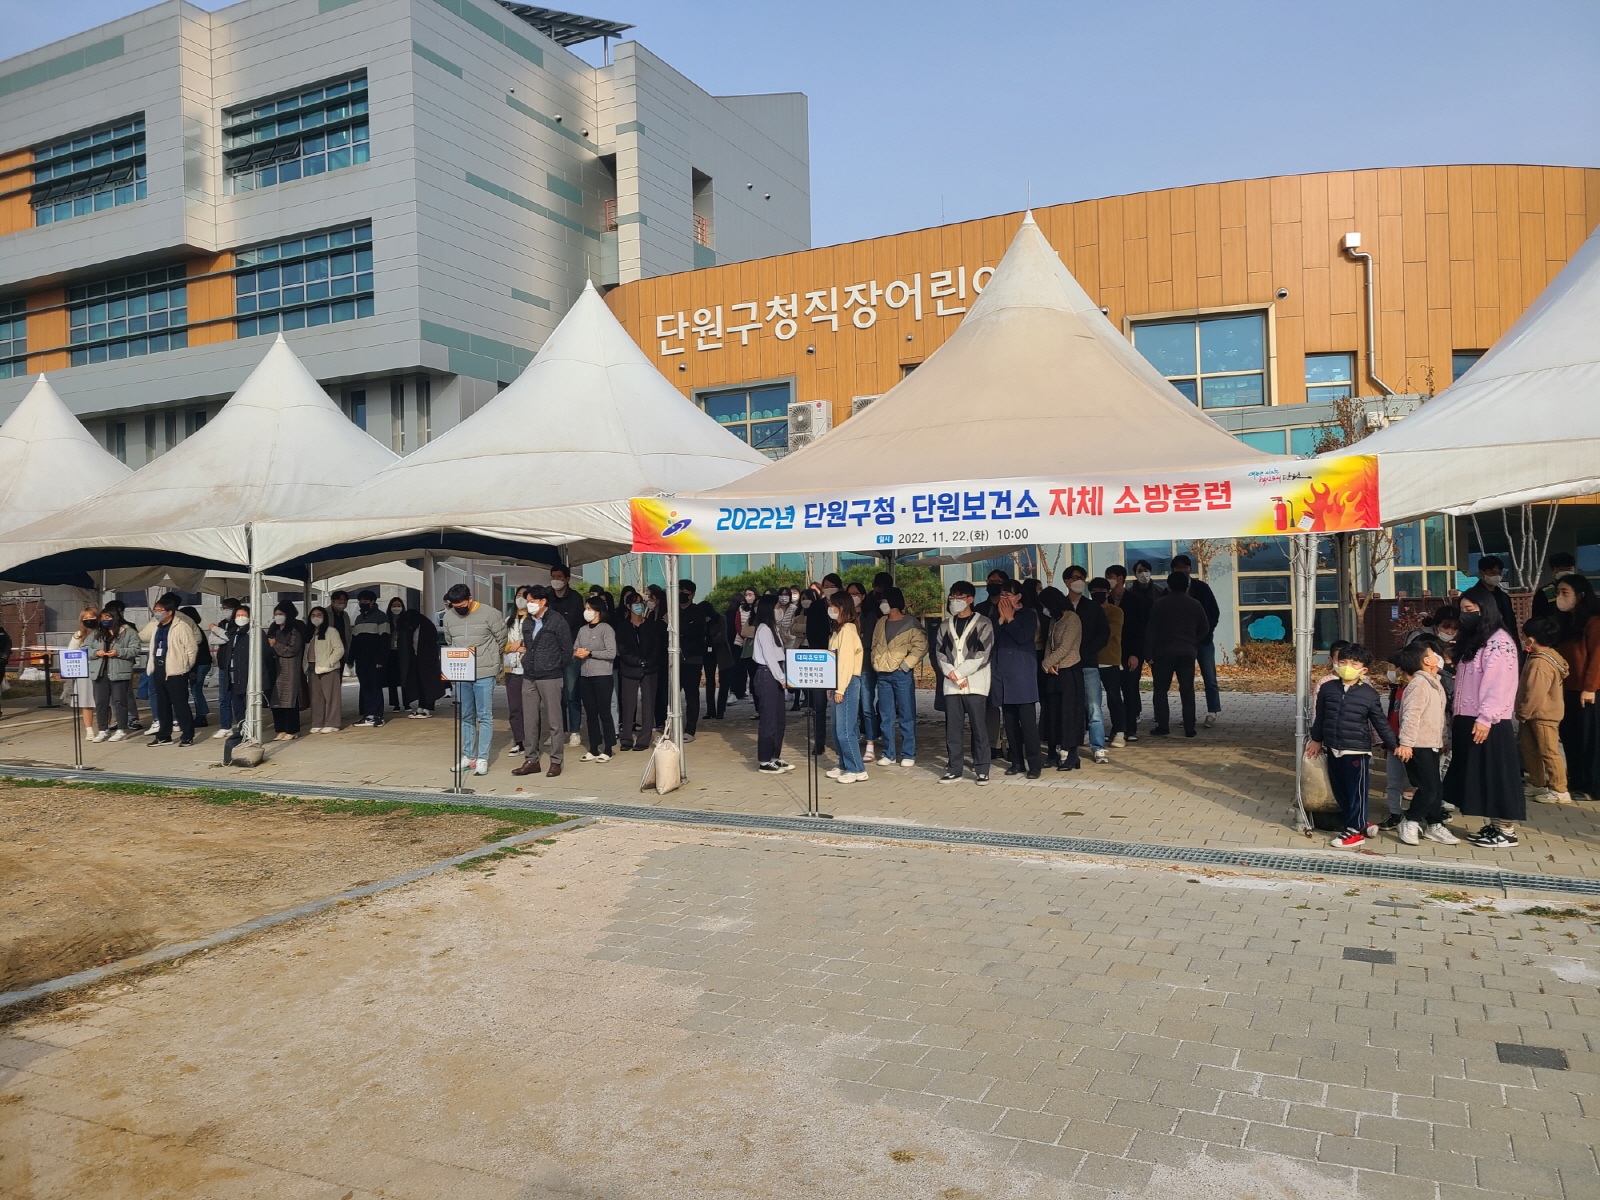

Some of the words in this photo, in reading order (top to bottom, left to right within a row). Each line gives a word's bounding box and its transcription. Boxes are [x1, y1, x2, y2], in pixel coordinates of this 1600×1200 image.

[716, 504, 796, 531] 2022년
[1049, 485, 1104, 517] 자체
[1113, 480, 1232, 514] 소방훈련
[898, 533, 928, 544] 2022.
[932, 531, 949, 543] 11.
[952, 529, 989, 542] 22.(화)
[997, 528, 1029, 540] 10:00
